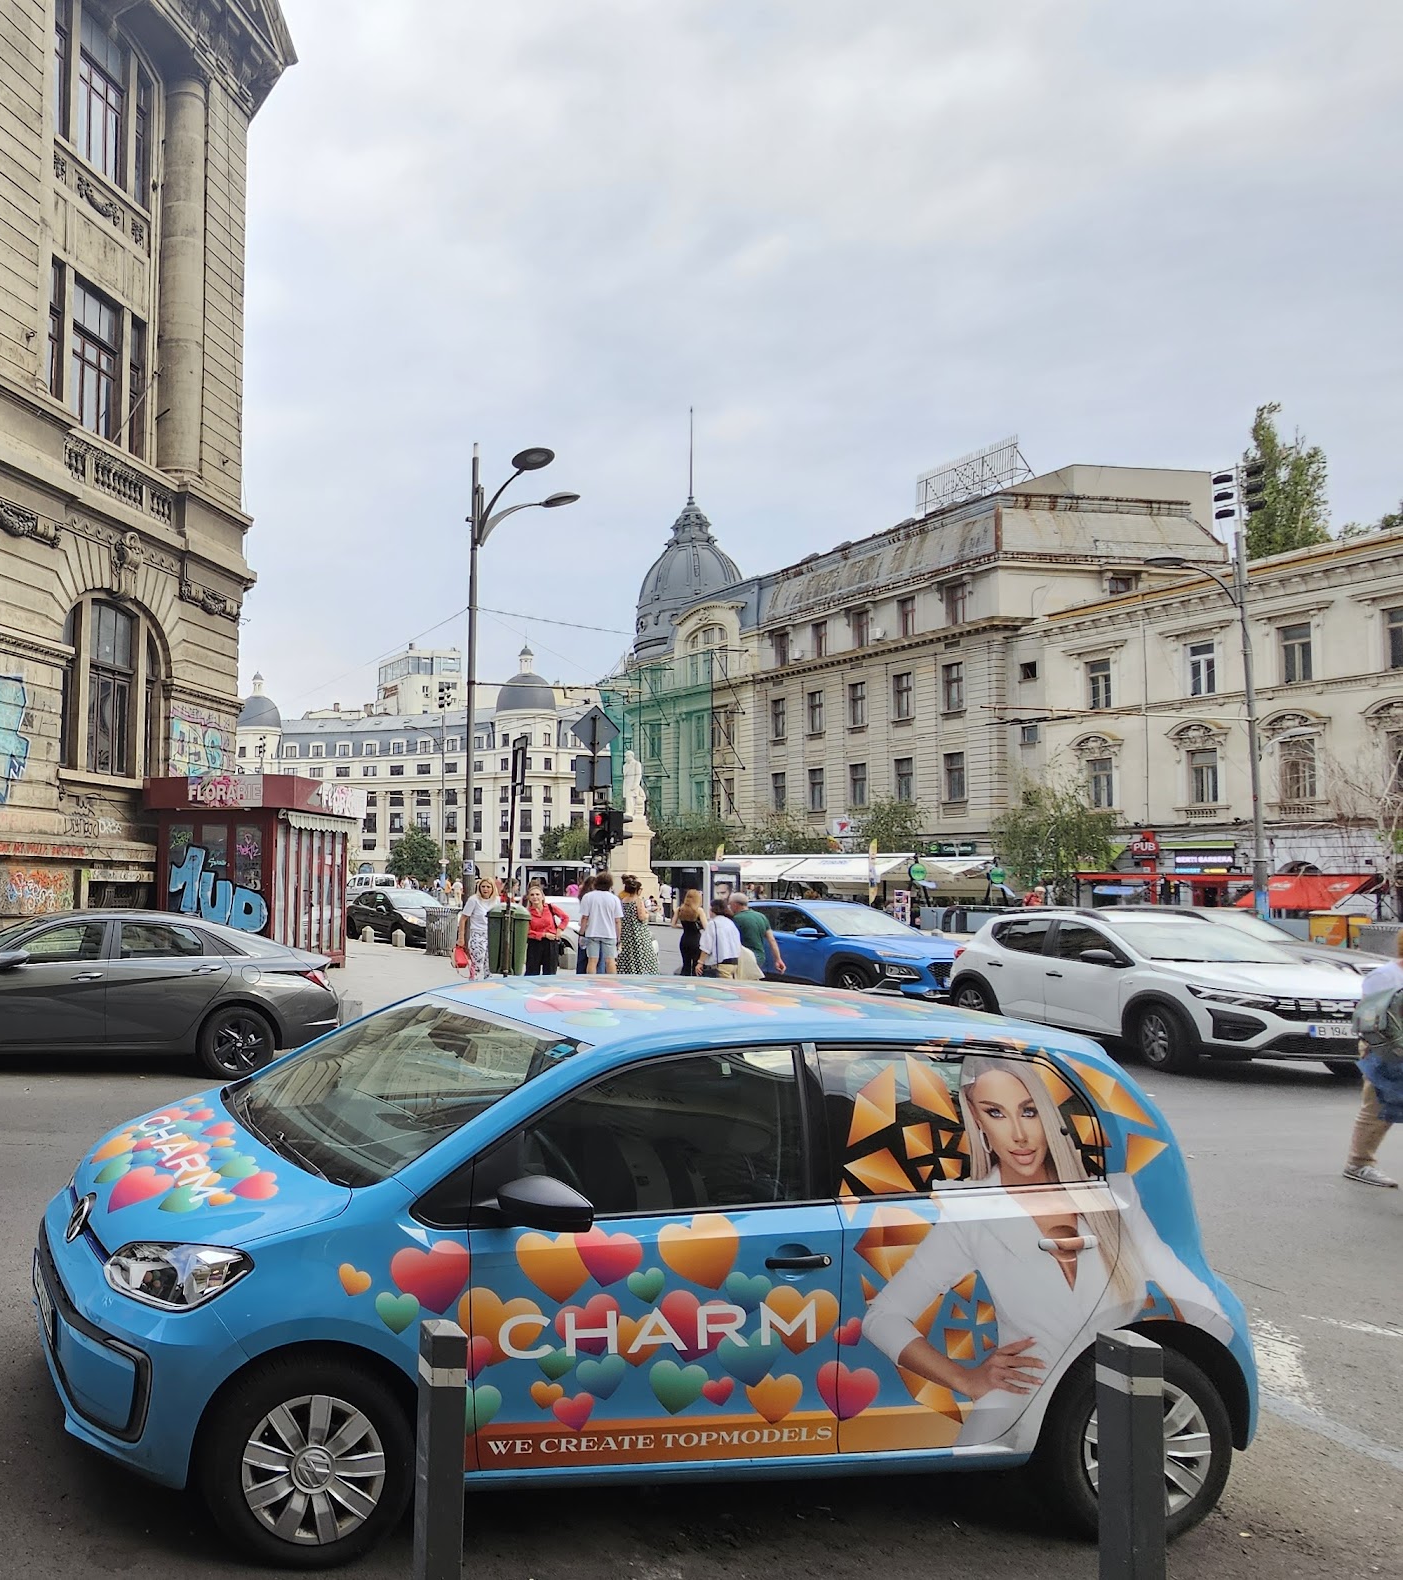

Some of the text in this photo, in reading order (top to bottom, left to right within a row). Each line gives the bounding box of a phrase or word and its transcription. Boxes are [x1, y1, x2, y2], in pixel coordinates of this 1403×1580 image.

[188, 783, 262, 802] FLORARIE
[1133, 842, 1156, 851] PUB
[1318, 1026, 1326, 1036] B
[1330, 1026, 1348, 1036] 194
[138, 1115, 227, 1204] CHARM
[498, 1299, 817, 1359] CHARM
[487, 1426, 833, 1456] WE CREATE TOPMODELS
